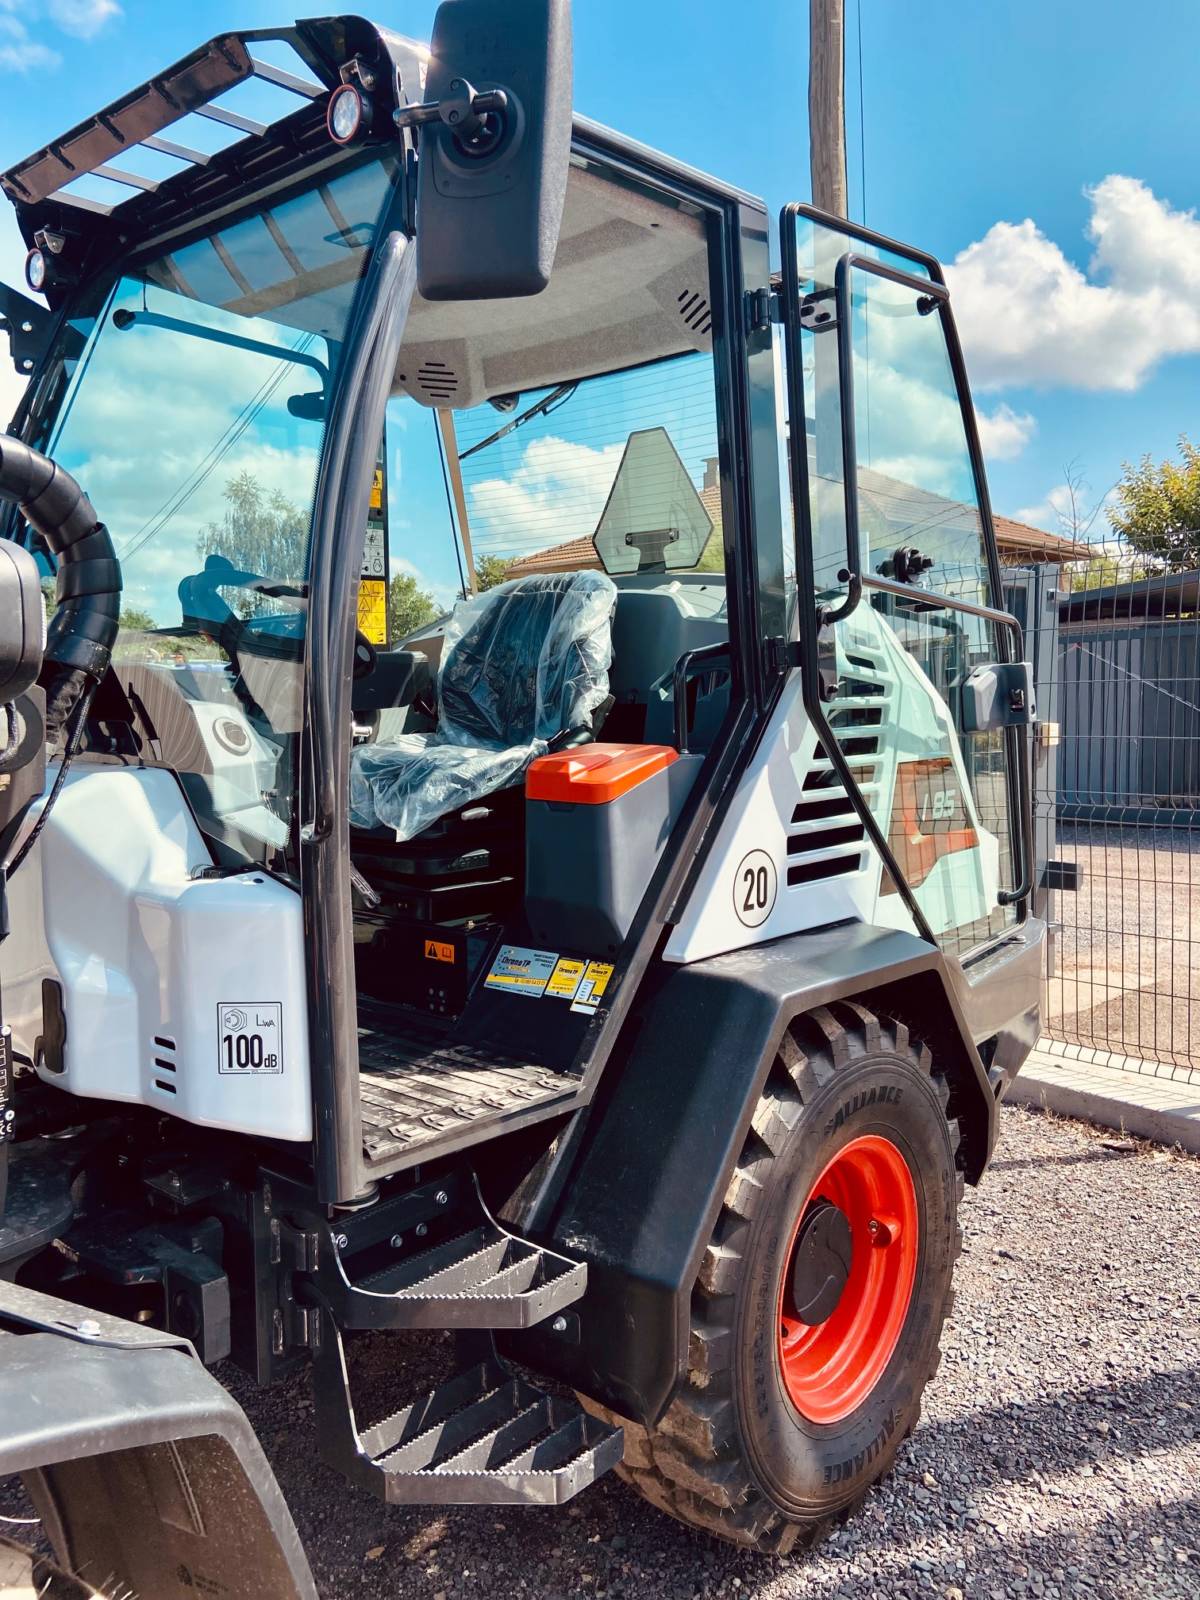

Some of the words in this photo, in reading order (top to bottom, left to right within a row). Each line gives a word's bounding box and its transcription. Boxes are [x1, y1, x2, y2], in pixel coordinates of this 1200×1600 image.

[743, 866, 768, 912] 20
[831, 1085, 904, 1137] ALLIANCE
[822, 1407, 896, 1488] ALLIANCE
